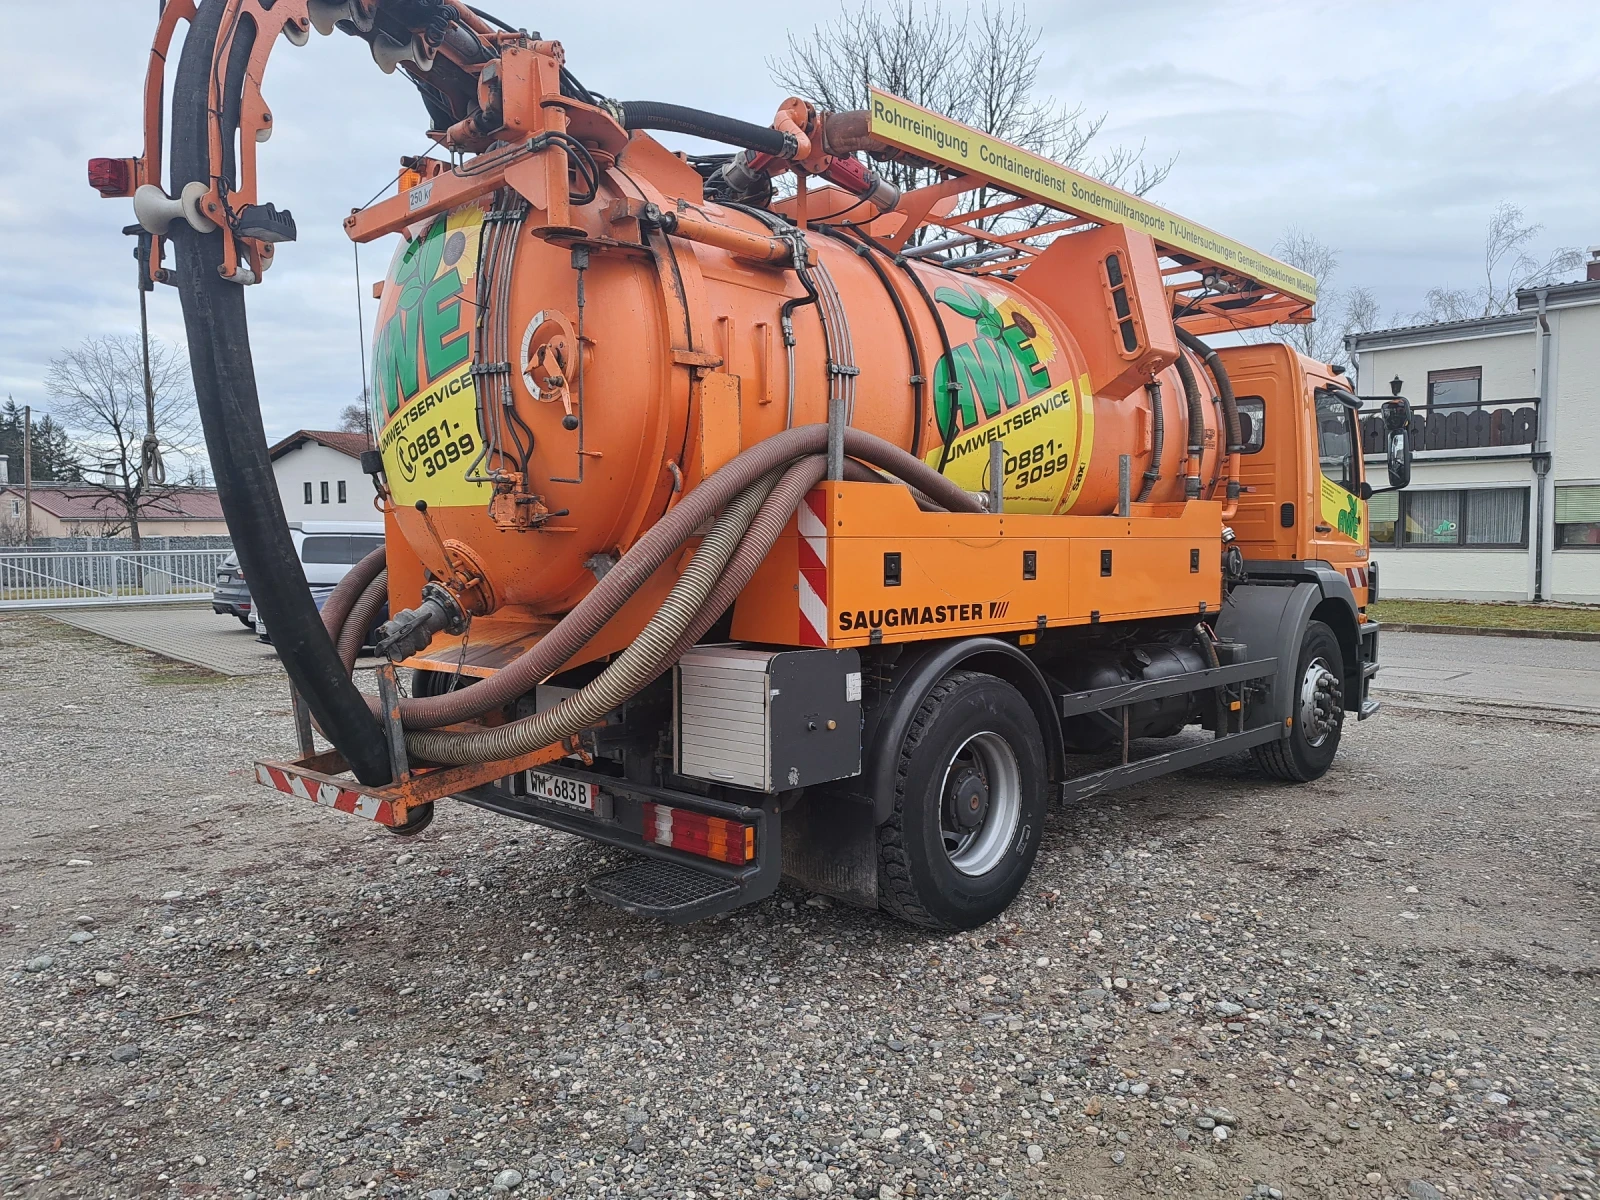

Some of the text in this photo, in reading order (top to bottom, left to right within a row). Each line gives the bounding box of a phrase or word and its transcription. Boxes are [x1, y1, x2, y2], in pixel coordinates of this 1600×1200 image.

[410, 190, 423, 206] 250
[874, 100, 968, 158] Rohrreinigung
[979, 144, 1066, 193] Containerdienst
[1071, 181, 1165, 231] Sondermülltransporte
[1169, 220, 1237, 261] TV-Untersuchungen
[380, 372, 473, 454] UMWELTSERVICE
[946, 389, 1071, 463] UMWELTSERVICE
[422, 433, 475, 478] 3099
[1015, 453, 1068, 490] 3099
[838, 603, 983, 631] SAUGMASTER
